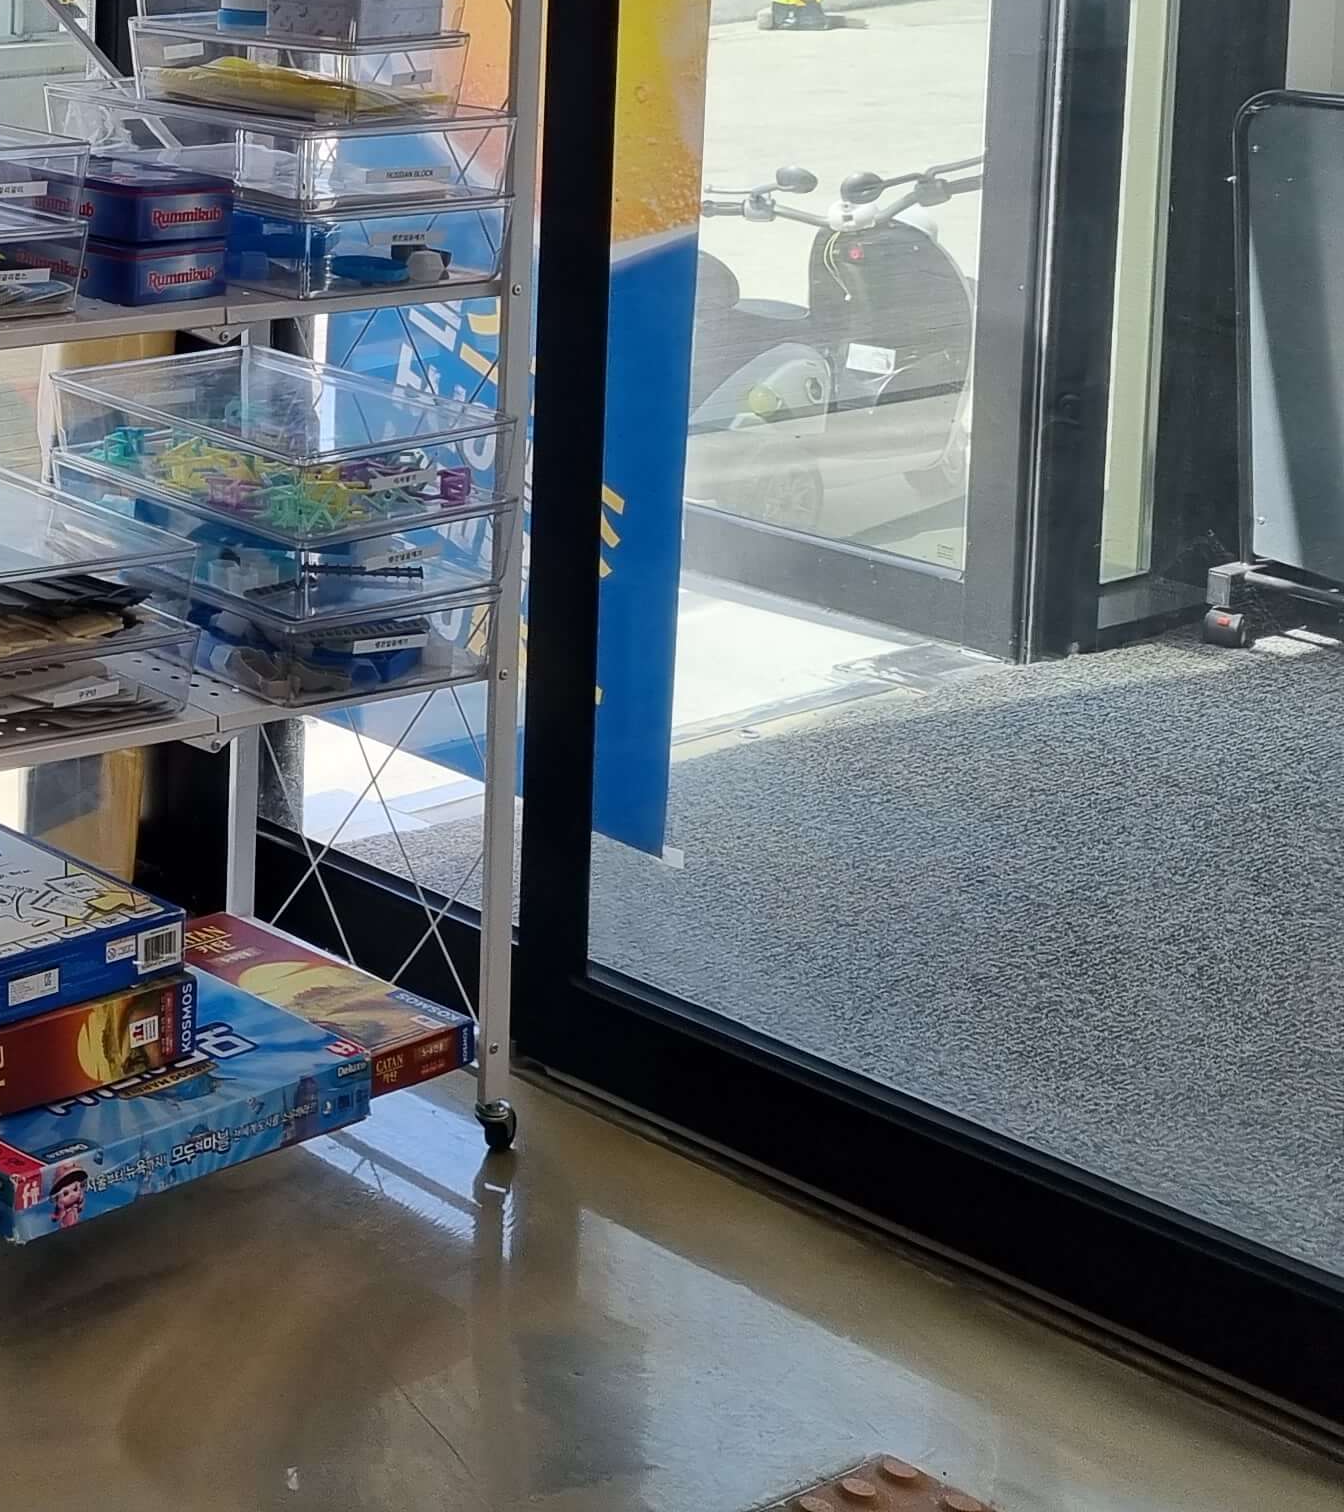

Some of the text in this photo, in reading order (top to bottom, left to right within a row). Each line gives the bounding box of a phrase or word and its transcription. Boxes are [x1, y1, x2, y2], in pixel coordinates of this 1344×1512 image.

[414, 169, 434, 178] BLOCK
[151, 205, 224, 231] Rummikub
[147, 266, 217, 293] Rummikub
[180, 982, 194, 1053] KOSMOS
[394, 990, 463, 1023] KOSMOS
[336, 1060, 369, 1079] Deluxe
[374, 1053, 405, 1073] CATAN
